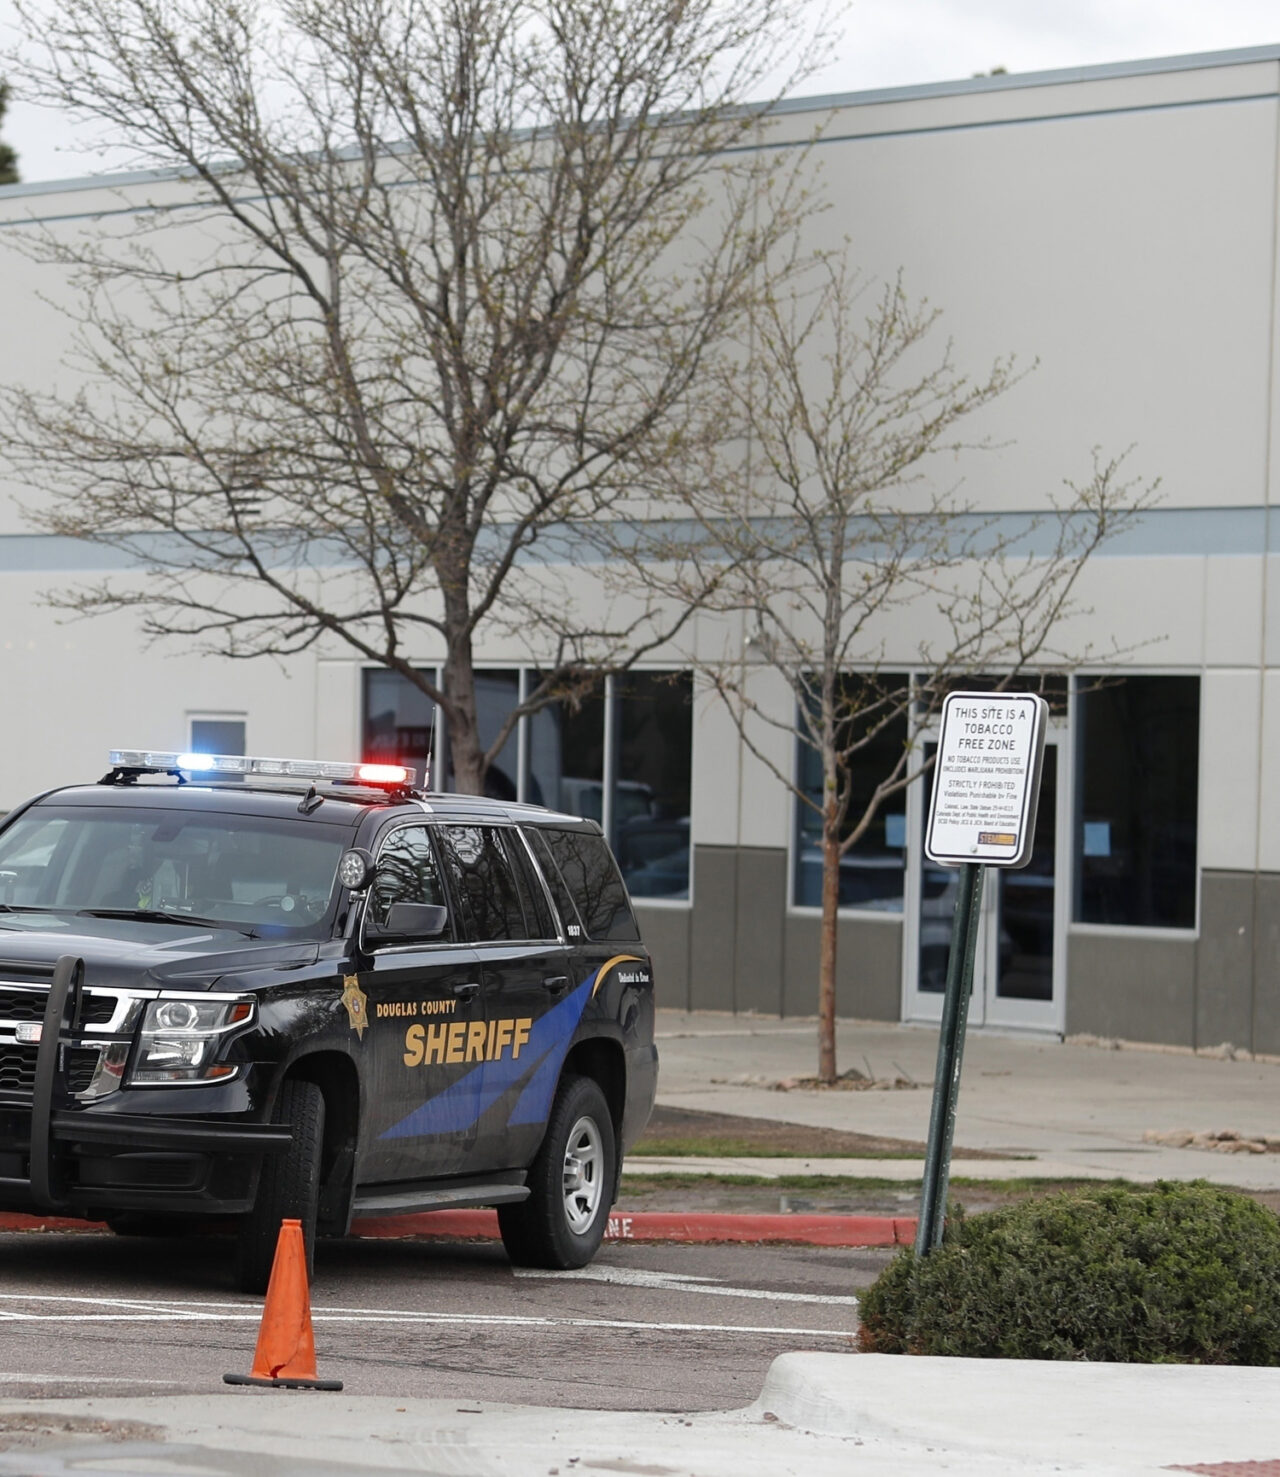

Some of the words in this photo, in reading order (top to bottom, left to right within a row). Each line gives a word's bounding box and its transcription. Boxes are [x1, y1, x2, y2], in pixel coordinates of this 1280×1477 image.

[955, 708, 977, 719] THIS
[982, 708, 1002, 720] SITE
[1006, 709, 1015, 720] IS
[1019, 710, 1026, 720] A
[964, 723, 1013, 735] TOBACCO
[958, 738, 983, 750] FREE
[988, 739, 1016, 751] ZONE
[948, 780, 977, 788] STRICTLY
[979, 781, 1015, 789] PROHIBITED
[377, 1002, 418, 1018] DOUGLAS
[421, 1000, 457, 1015] COUNTY
[403, 1018, 533, 1067] SHERIFF
